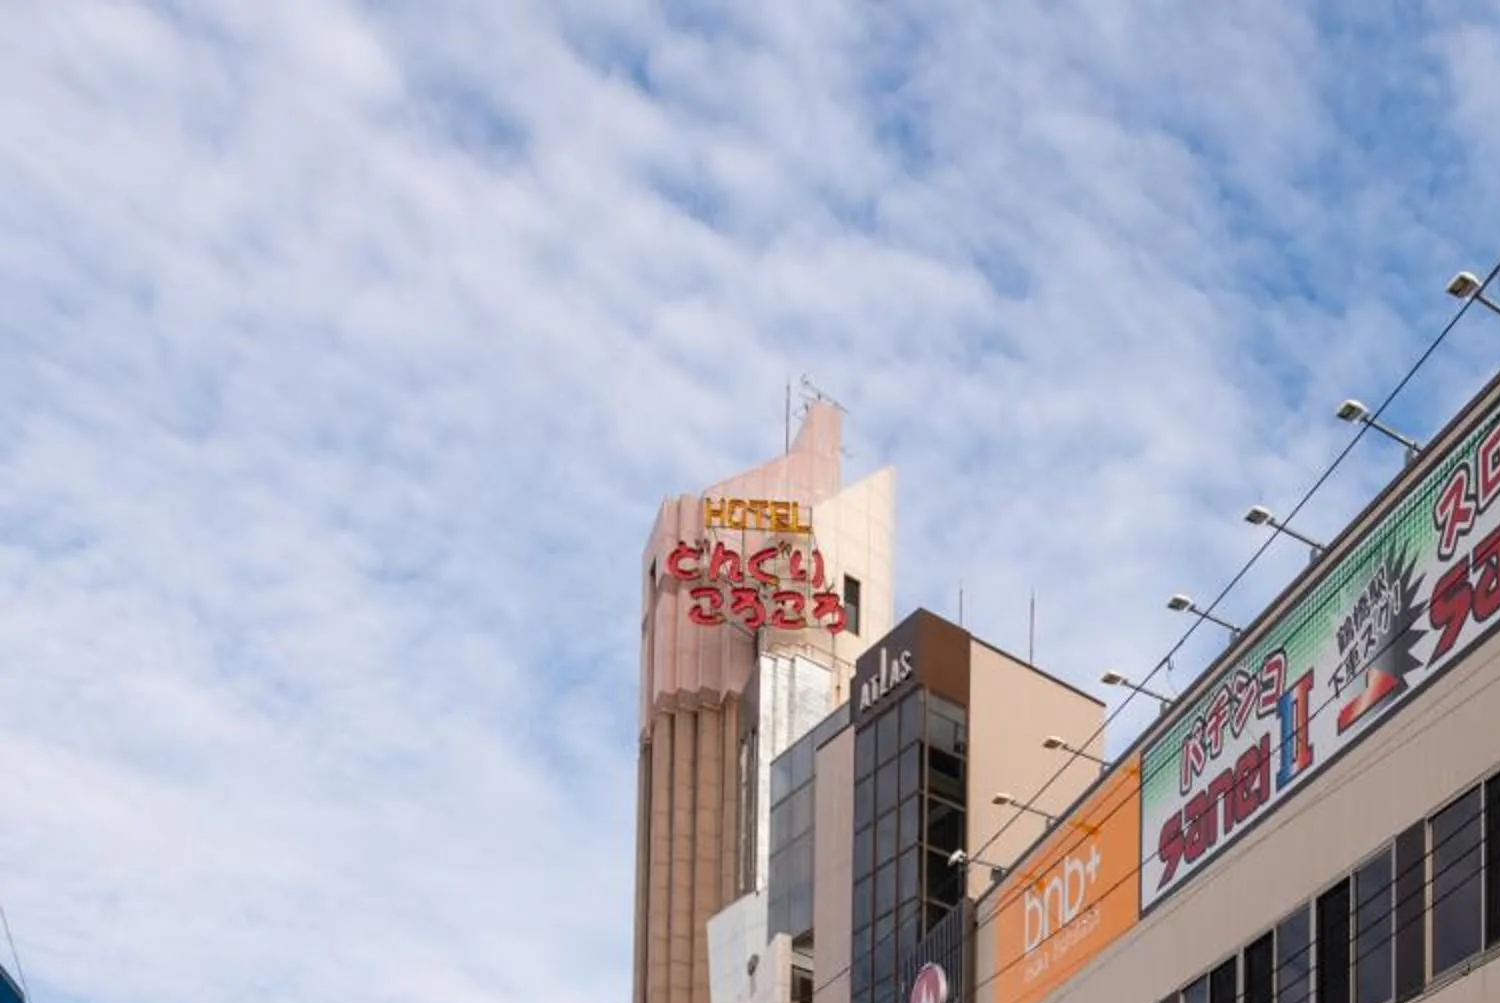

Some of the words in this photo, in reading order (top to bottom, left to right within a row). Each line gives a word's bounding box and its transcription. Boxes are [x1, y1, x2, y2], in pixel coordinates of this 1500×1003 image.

[704, 496, 812, 534] HOTEL
[667, 539, 825, 588] どんぐり
[688, 585, 849, 634] ころころ
[1180, 646, 1287, 794] パチンコ
